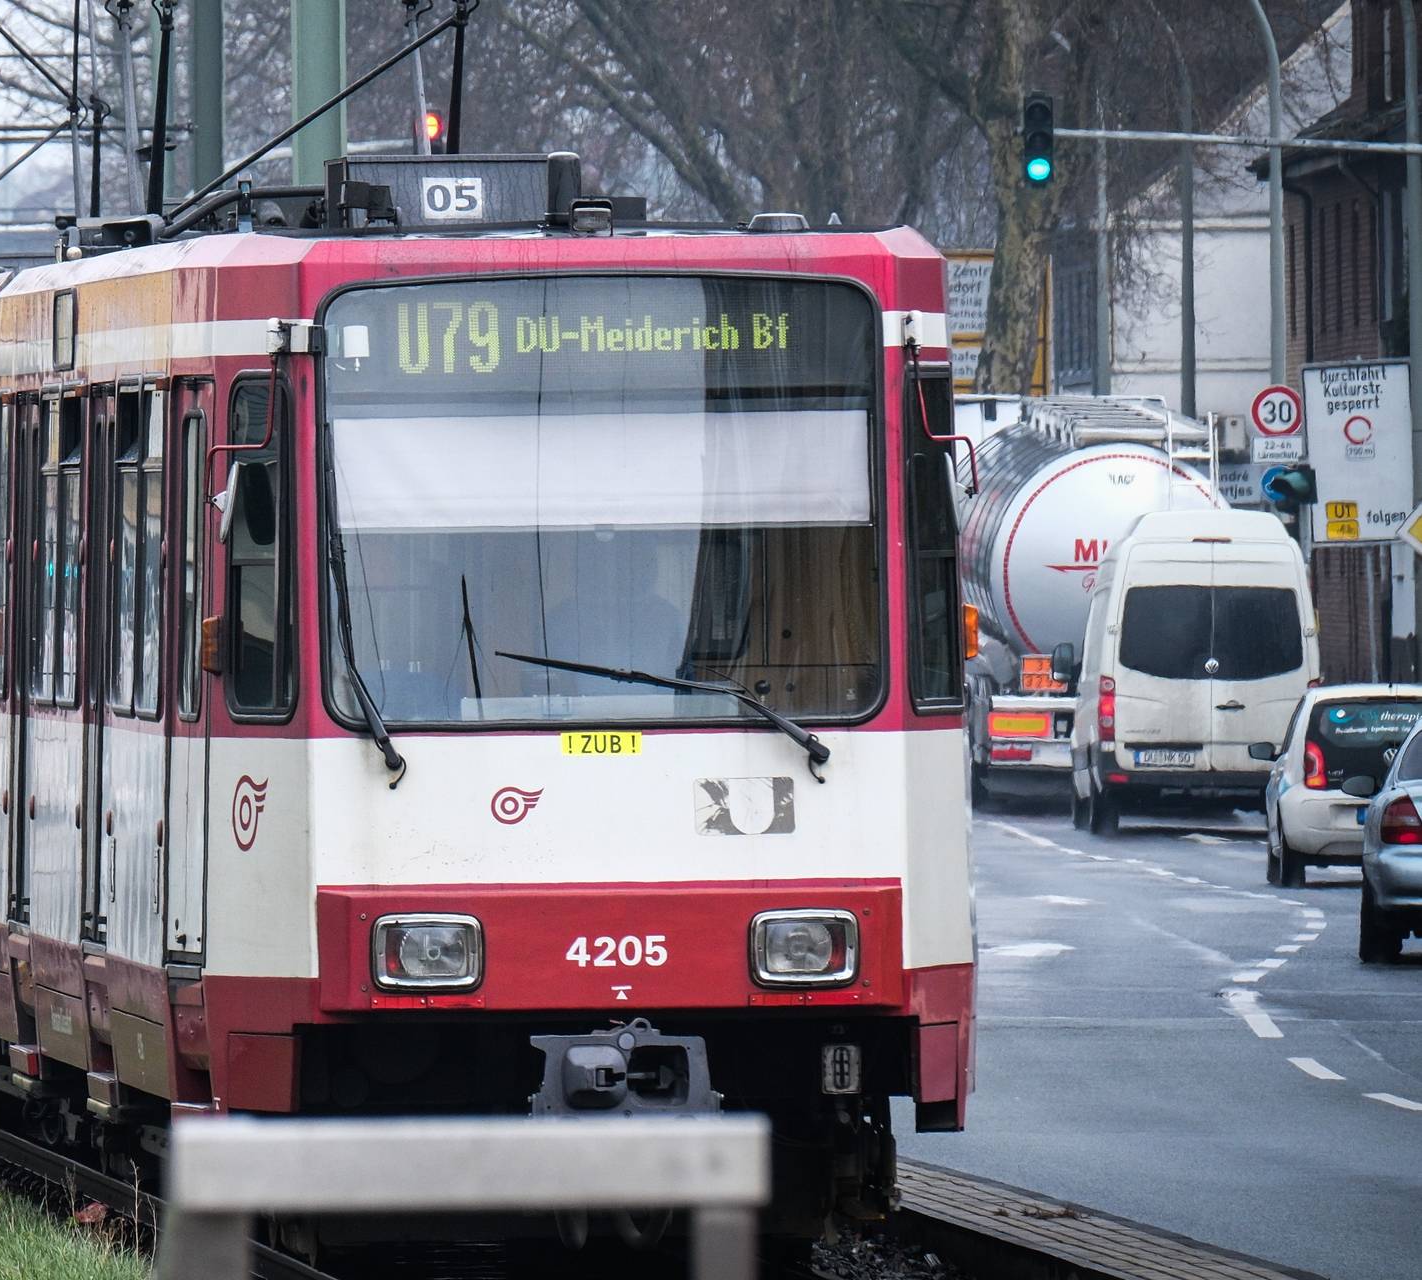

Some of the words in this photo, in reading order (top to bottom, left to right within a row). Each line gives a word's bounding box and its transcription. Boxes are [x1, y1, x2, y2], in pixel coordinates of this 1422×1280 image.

[426, 184, 478, 212] 05
[398, 302, 501, 374] U79
[516, 313, 740, 353] DU-Meiderich
[752, 312, 789, 350] Bf
[1320, 364, 1387, 384] Durchfahrt
[1323, 381, 1384, 398] Kulturstr.
[1262, 400, 1292, 424] 30
[1327, 395, 1380, 416] gesperrt
[1219, 472, 1250, 482] ndré
[1366, 509, 1407, 526] folgen
[581, 735, 622, 754] ZUB
[565, 935, 668, 968] 4205
